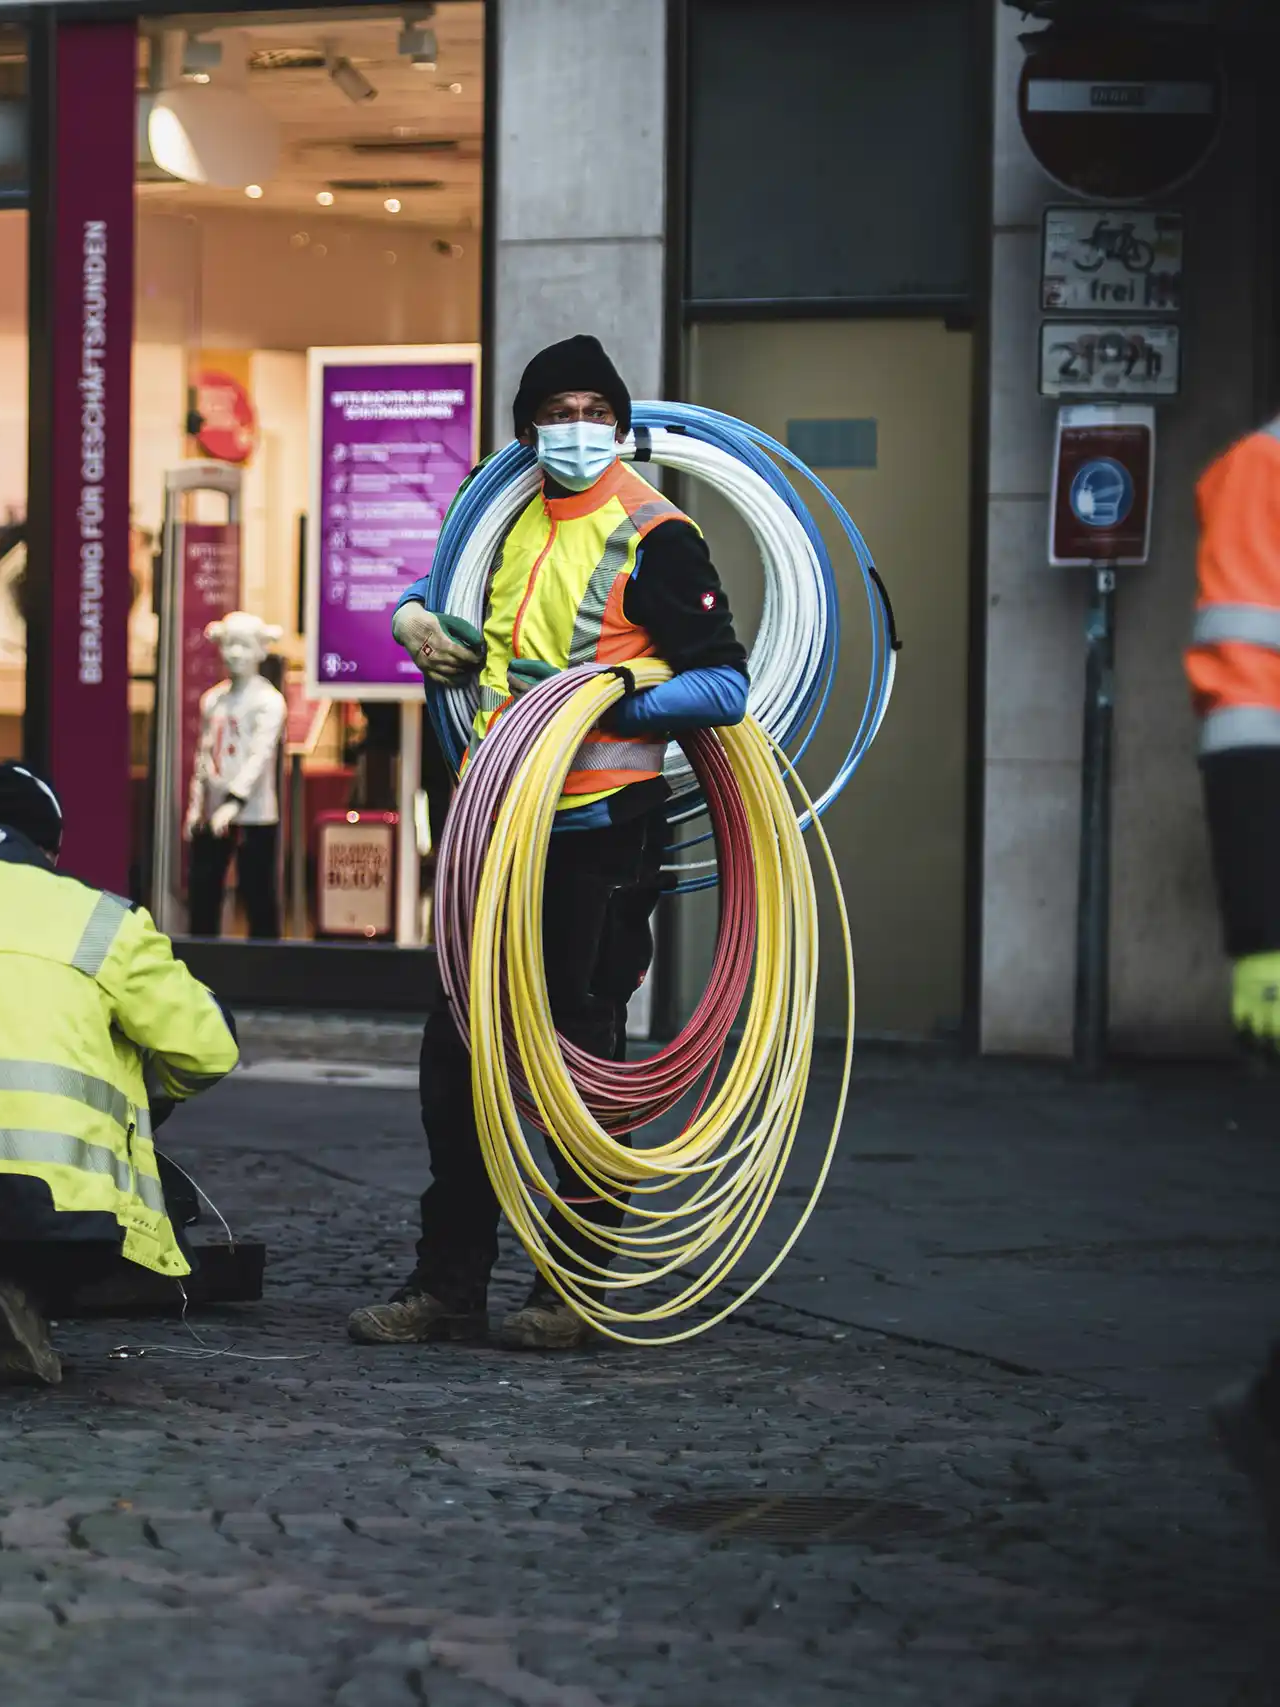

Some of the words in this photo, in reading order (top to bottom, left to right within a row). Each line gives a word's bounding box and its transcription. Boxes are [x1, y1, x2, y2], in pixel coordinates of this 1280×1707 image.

[1090, 277, 1135, 302] frei
[77, 220, 107, 483] GESCHÄFTSKUNDEN
[76, 485, 105, 538] FÜR
[79, 540, 105, 684] BERATUNG
